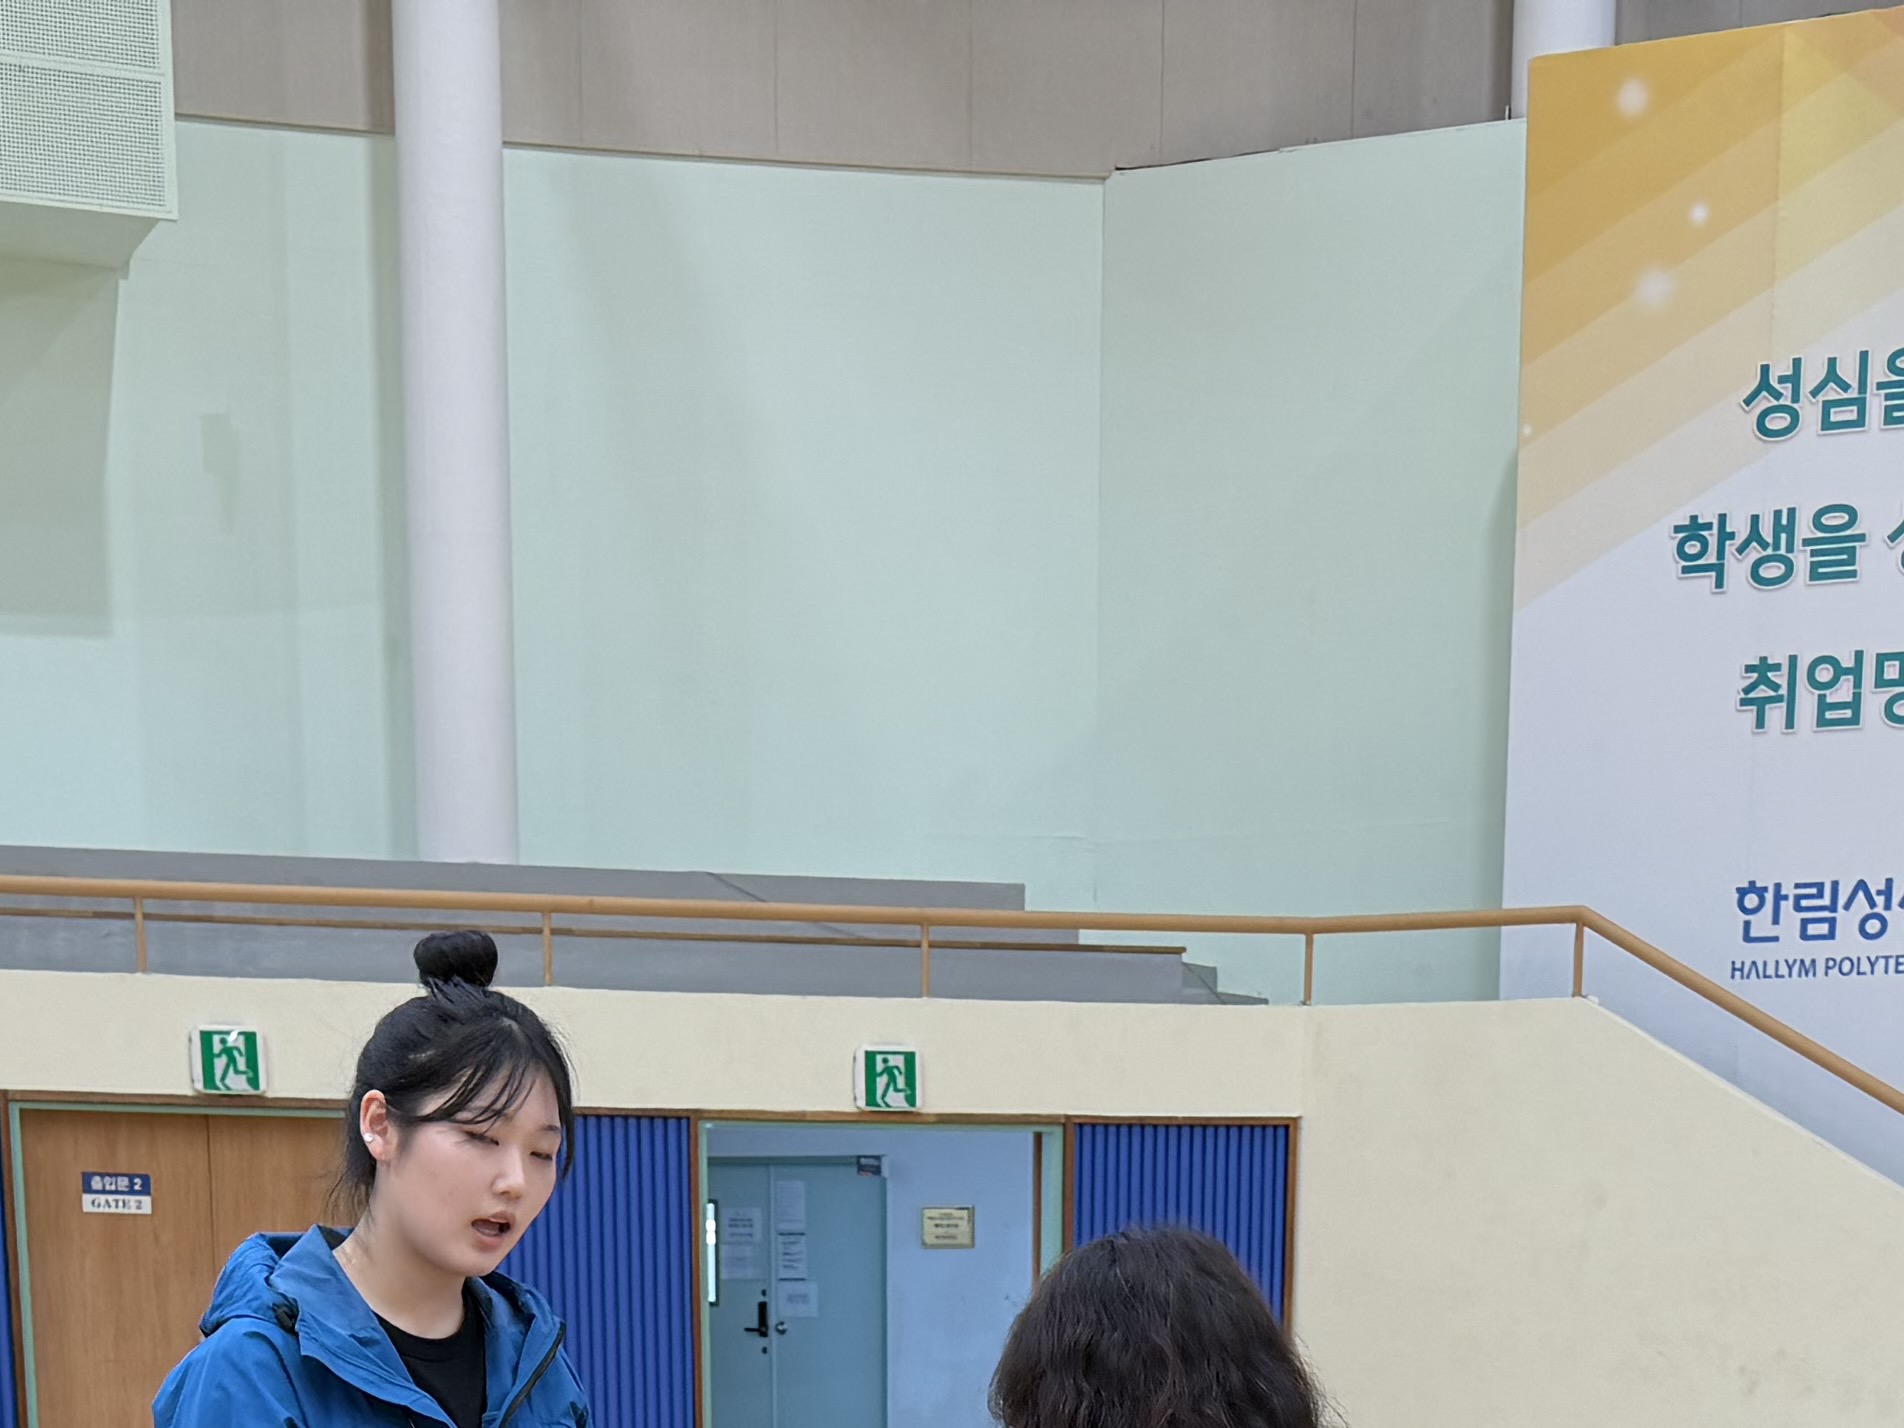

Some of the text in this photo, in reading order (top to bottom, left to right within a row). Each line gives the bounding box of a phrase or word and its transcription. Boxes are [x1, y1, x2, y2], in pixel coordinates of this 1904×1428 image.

[1673, 503, 1866, 590] 학생을
[1730, 957, 1816, 980] HALLYM
[133, 1177, 142, 1190] 2
[91, 1197, 143, 1210] GATE 2
